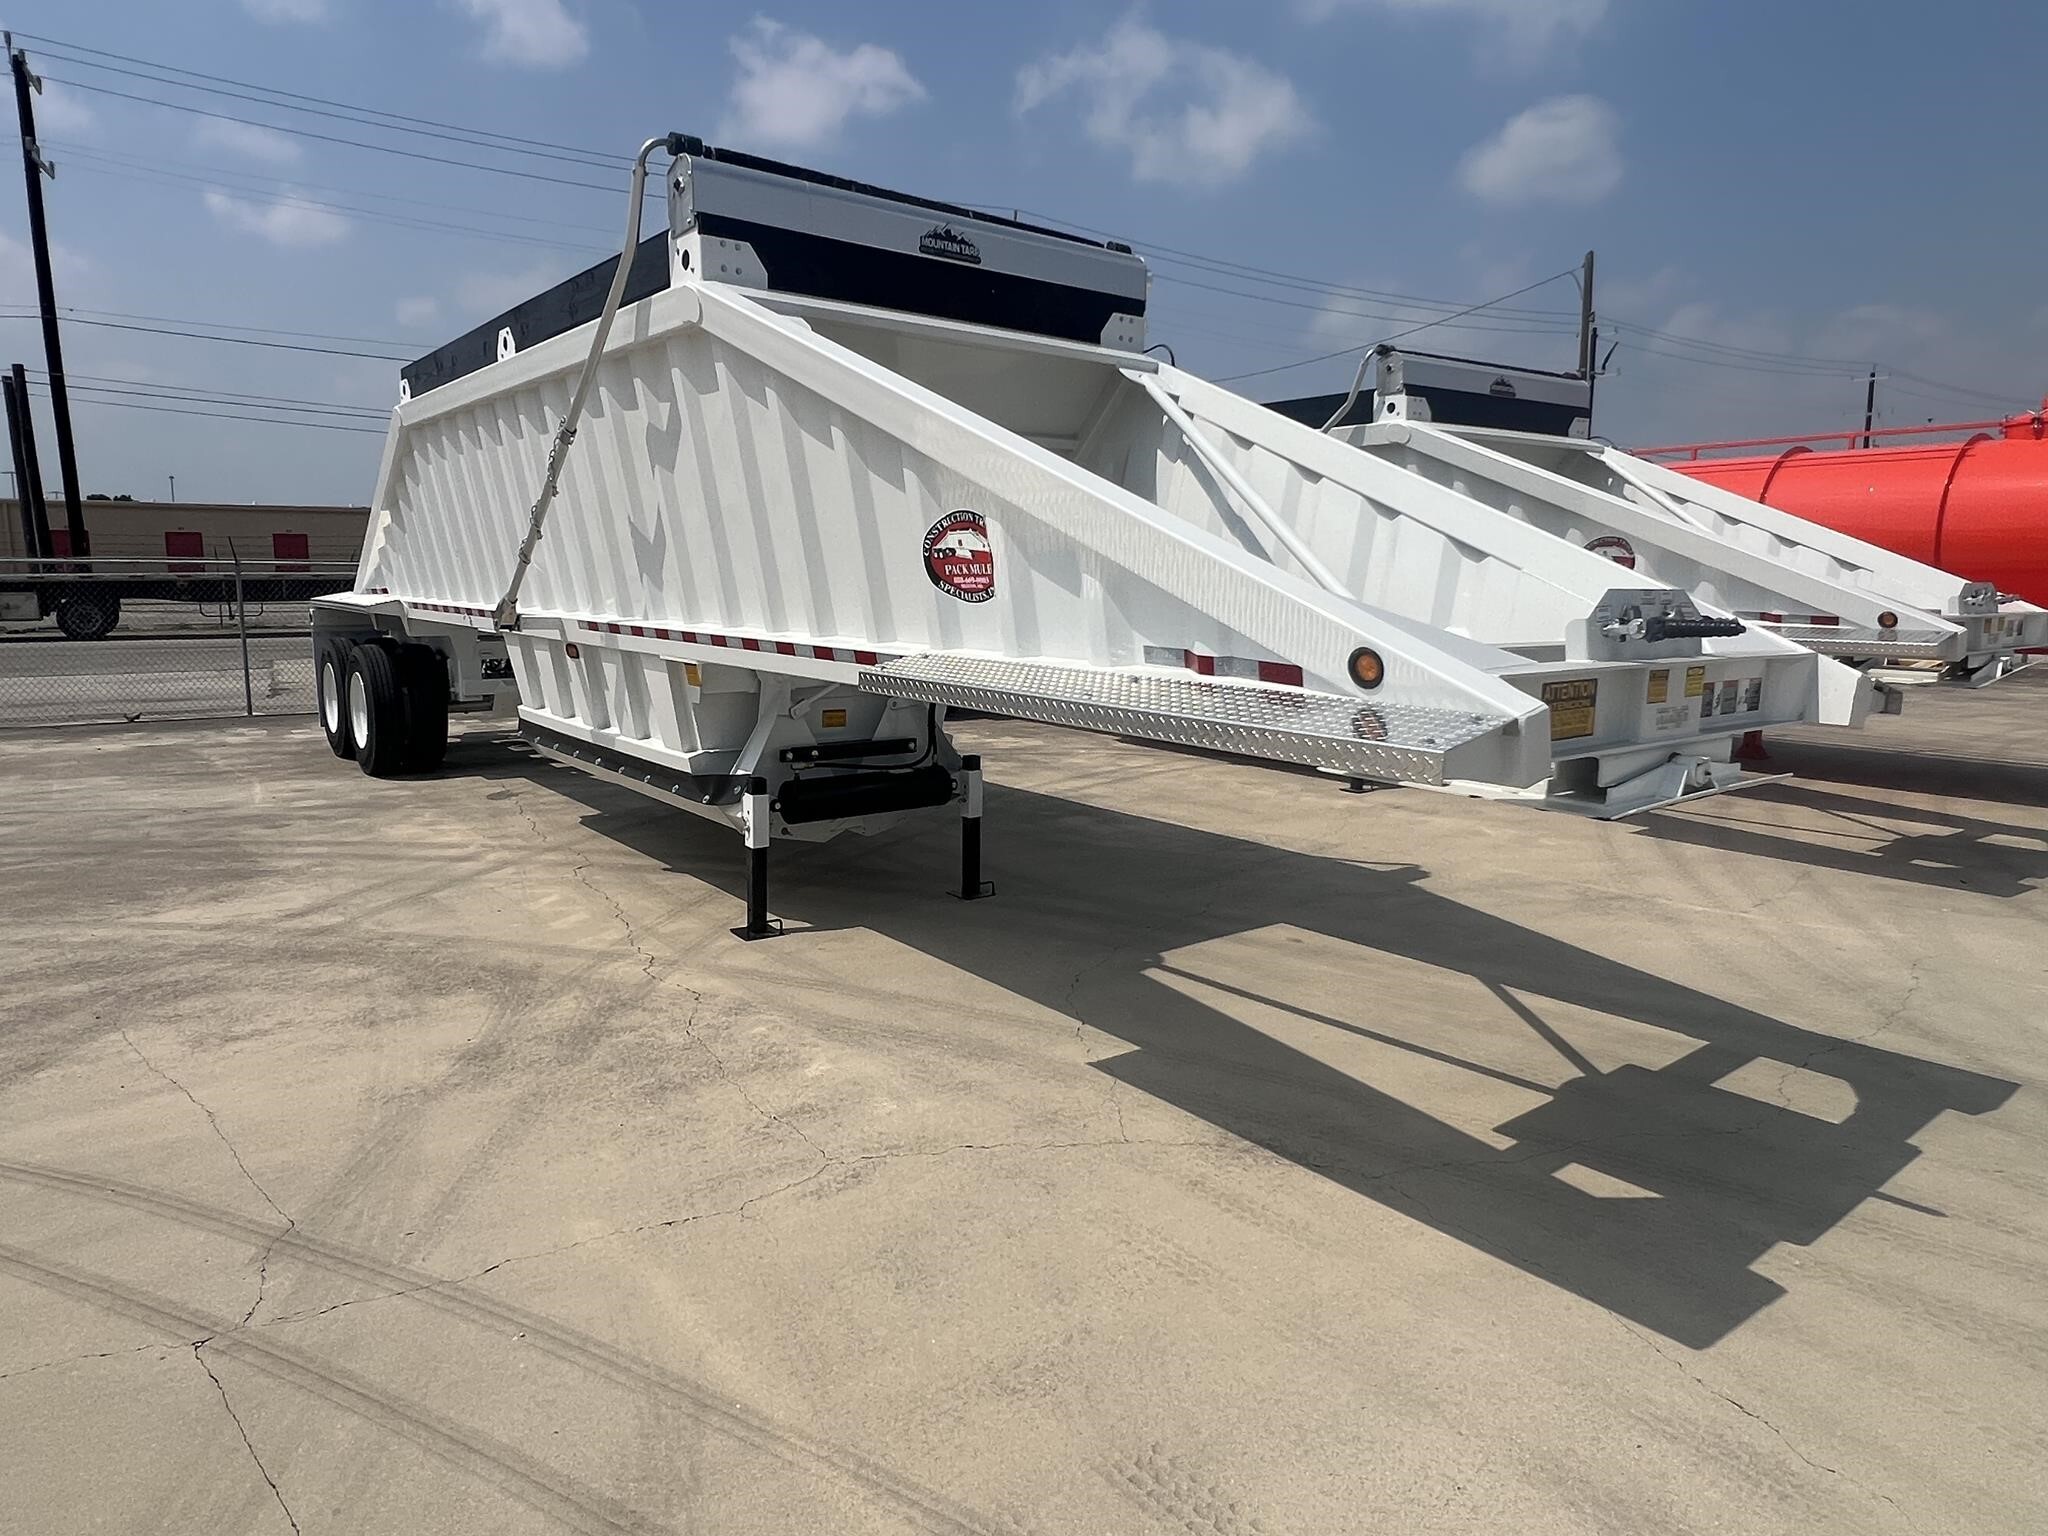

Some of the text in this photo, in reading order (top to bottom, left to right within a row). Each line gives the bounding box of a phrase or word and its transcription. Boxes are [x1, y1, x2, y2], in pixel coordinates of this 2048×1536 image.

[921, 237, 961, 253] MOUNTAIN
[923, 512, 973, 556] CONSTRUCTION
[944, 563, 993, 575] PACK MULE
